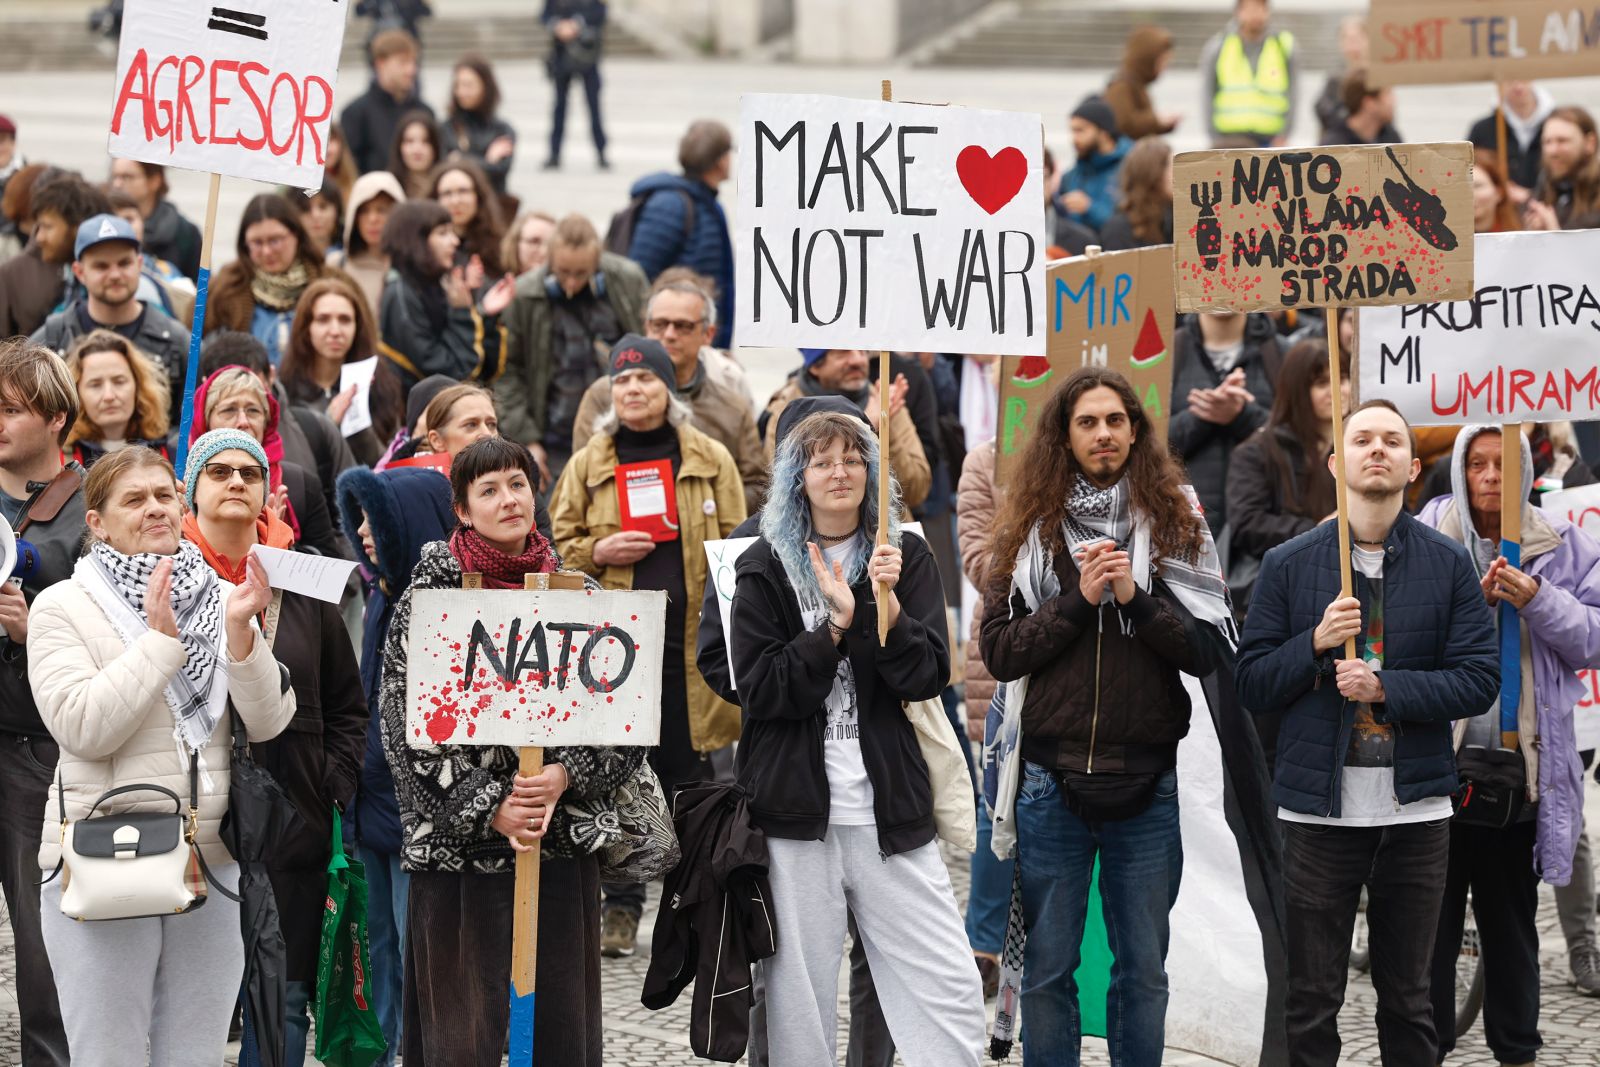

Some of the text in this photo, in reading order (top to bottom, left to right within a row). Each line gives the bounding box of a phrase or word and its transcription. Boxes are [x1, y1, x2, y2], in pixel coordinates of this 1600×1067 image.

[1459, 16, 1527, 59] TEL
[111, 48, 333, 166] AGRESOR
[754, 120, 938, 216] MAKE
[1232, 152, 1342, 205] NATO
[1272, 192, 1390, 234] VLADA
[1232, 228, 1348, 268] NAROD
[753, 227, 1035, 337] NOT WAR
[1280, 261, 1417, 306] STRADA
[1380, 335, 1421, 384] MI
[1431, 365, 1600, 417] UMIRAM
[463, 617, 636, 693] NATO
[836, 724, 844, 741] TO
